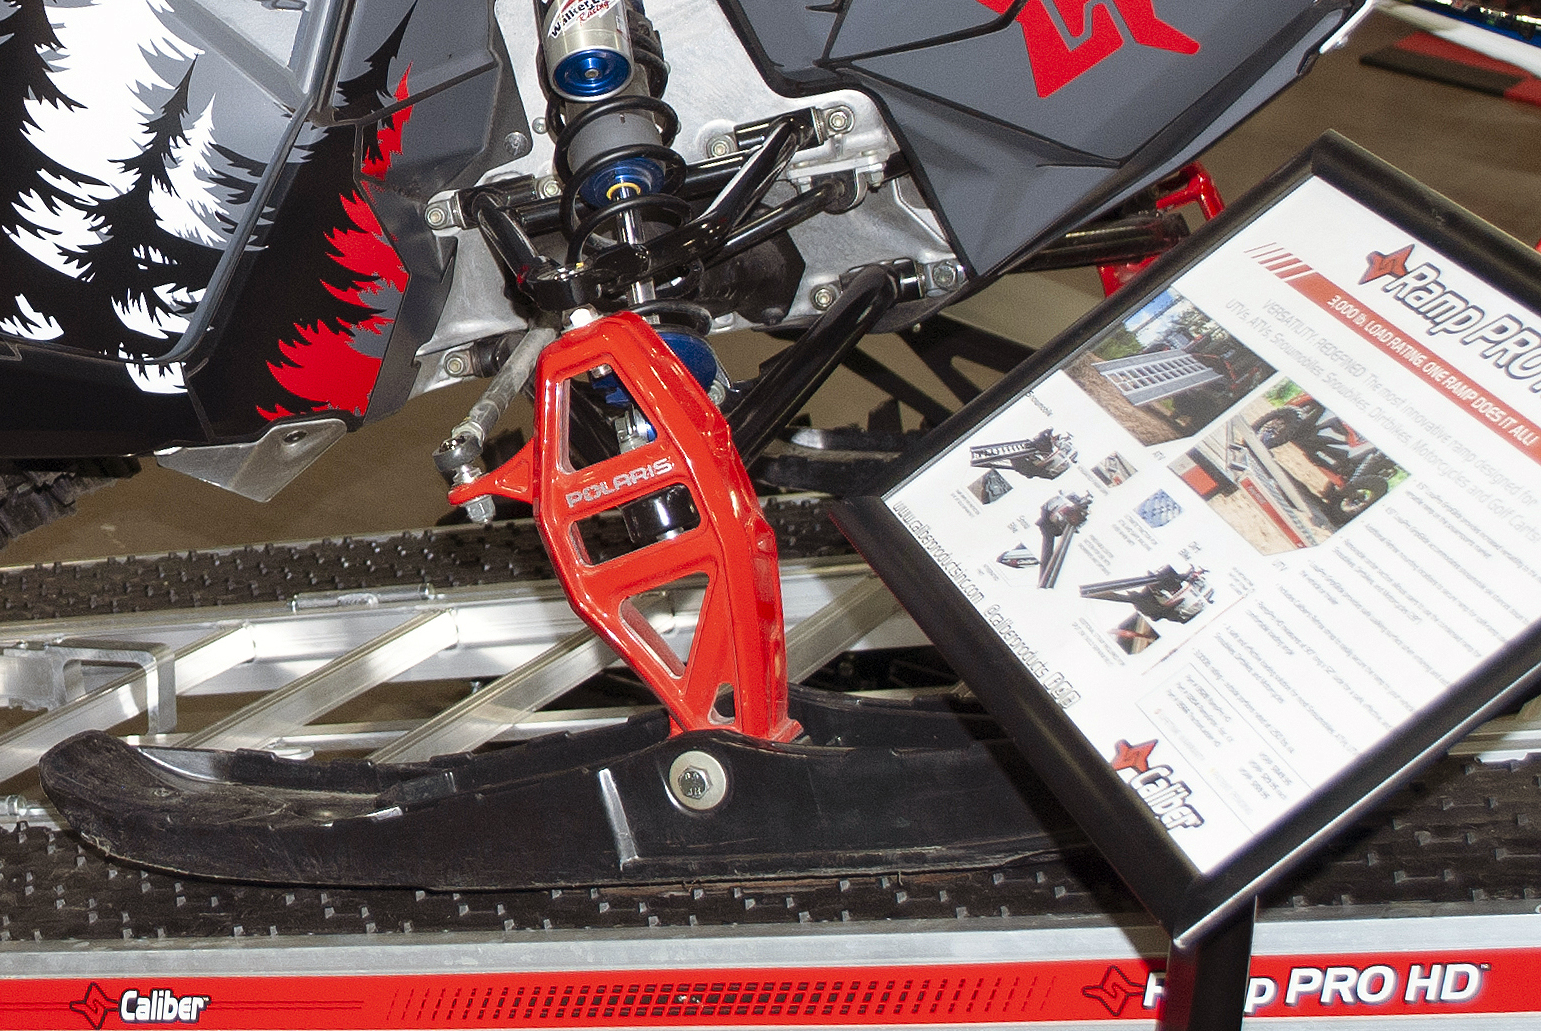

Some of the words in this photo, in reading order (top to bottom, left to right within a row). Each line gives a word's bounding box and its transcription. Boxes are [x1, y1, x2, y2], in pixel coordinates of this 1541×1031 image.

[1382, 261, 1486, 337] Ramp
[1326, 294, 1361, 319] 3,000
[1362, 319, 1395, 343] LOAD
[1420, 360, 1449, 381] ONE
[1440, 374, 1479, 402] RAMP
[1470, 395, 1507, 422] DOES
[1497, 414, 1518, 430] IT
[1508, 422, 1540, 445] ALL!
[1360, 373, 1386, 392] The
[1442, 439, 1478, 465] ramp
[1515, 488, 1541, 508] for
[566, 457, 676, 509] POLARIS
[1465, 482, 1494, 504] and
[892, 499, 987, 604] www.caliberproductsinc.com
[983, 603, 1050, 680] @caliberproducts
[1130, 764, 1204, 831] Caliber
[117, 989, 206, 1023] Caliber
[1142, 971, 1277, 1014] Rp
[1285, 964, 1398, 1007] PRO
[1403, 962, 1482, 1004] HD
